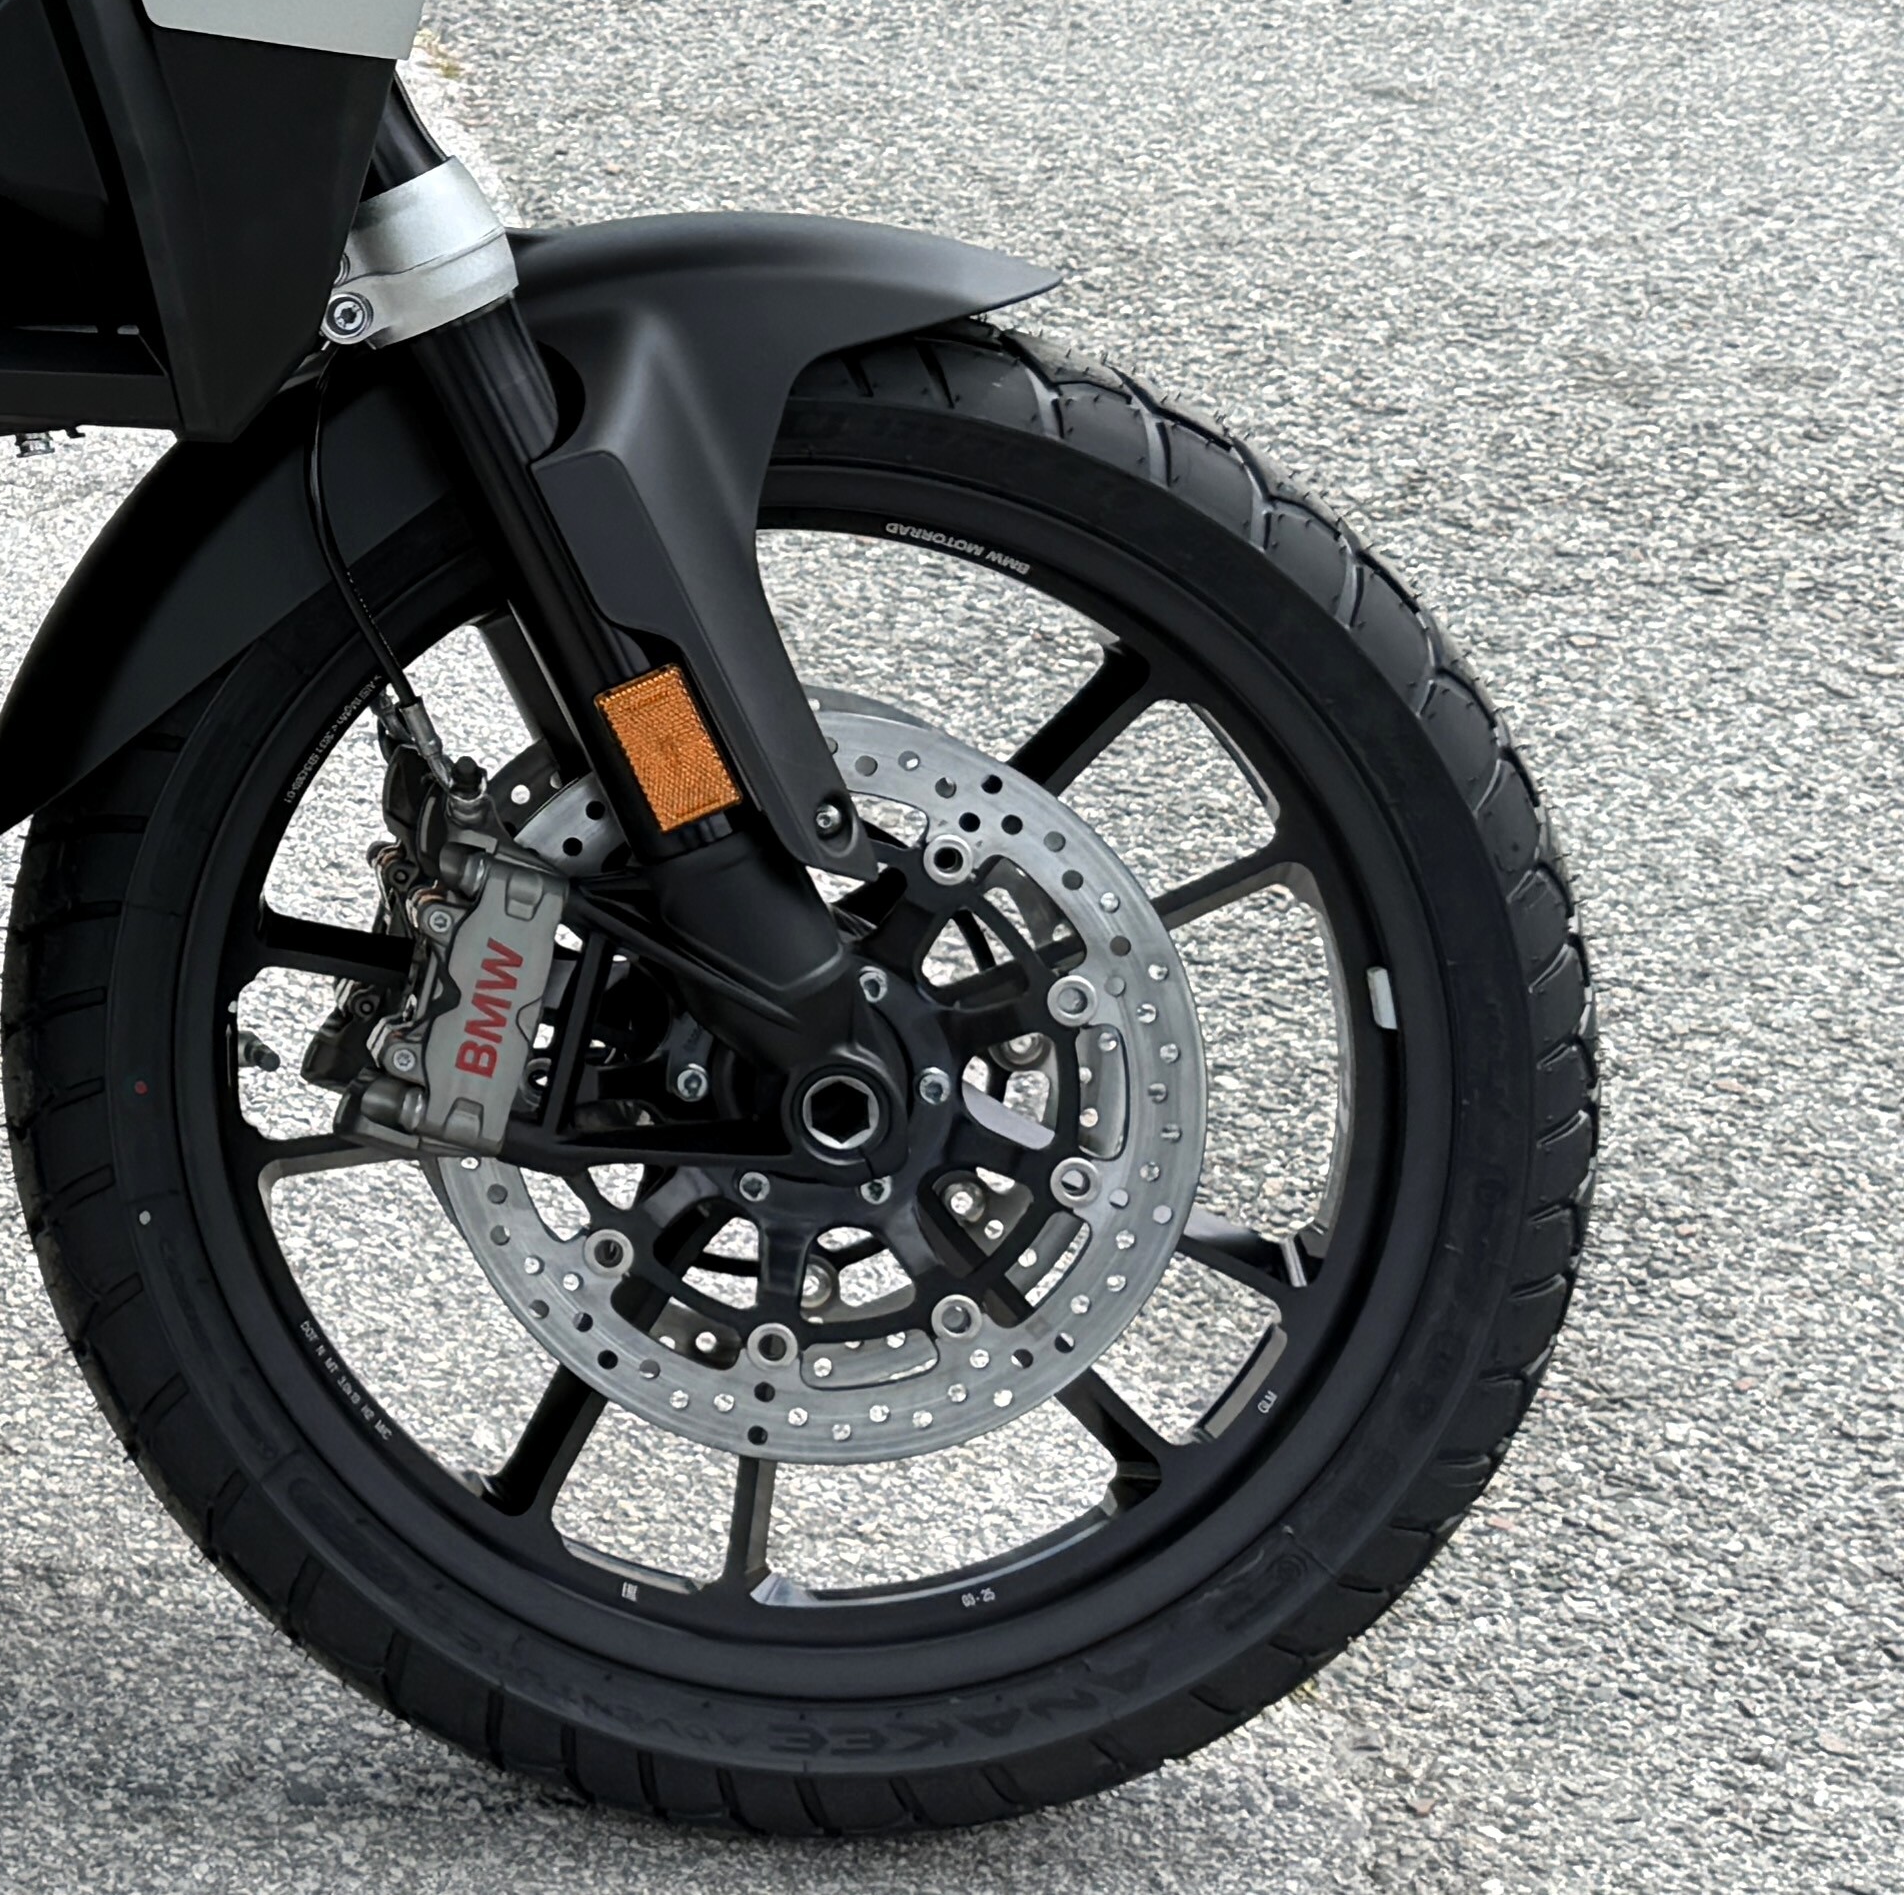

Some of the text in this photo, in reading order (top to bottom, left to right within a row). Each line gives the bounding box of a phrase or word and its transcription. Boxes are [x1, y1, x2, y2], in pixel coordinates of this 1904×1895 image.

[885, 522, 1031, 575] BMW MOTORRAD
[454, 937, 525, 1079] BMW
[767, 1658, 1151, 1756] ANAKEE
